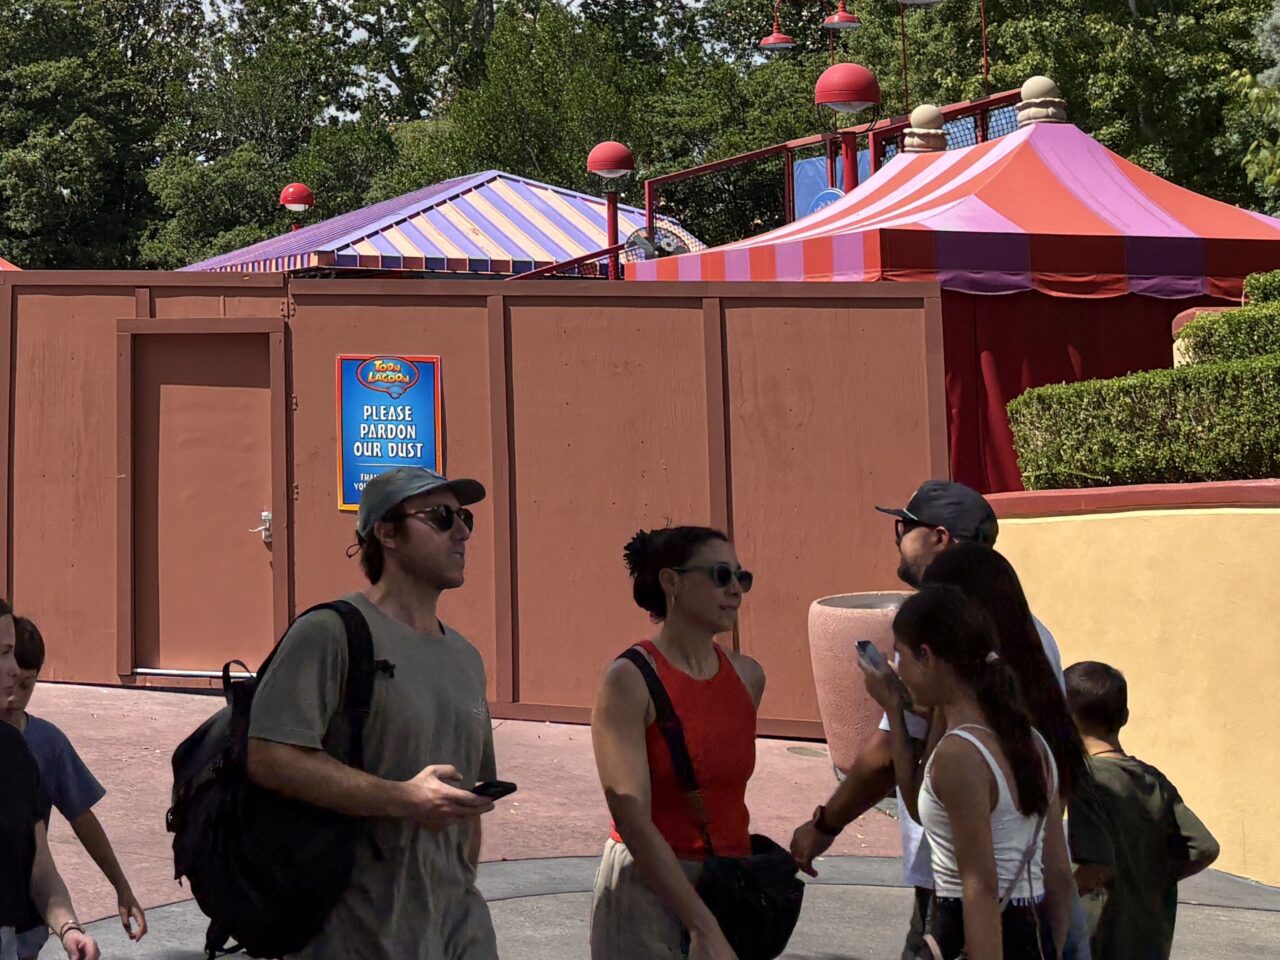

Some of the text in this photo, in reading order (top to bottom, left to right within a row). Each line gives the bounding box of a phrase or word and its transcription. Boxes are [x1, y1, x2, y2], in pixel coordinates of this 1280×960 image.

[367, 371, 410, 383] LAGOON
[363, 405, 413, 421] PLEASE
[360, 423, 416, 439] PARDON
[353, 442, 424, 458] OUR DUST
